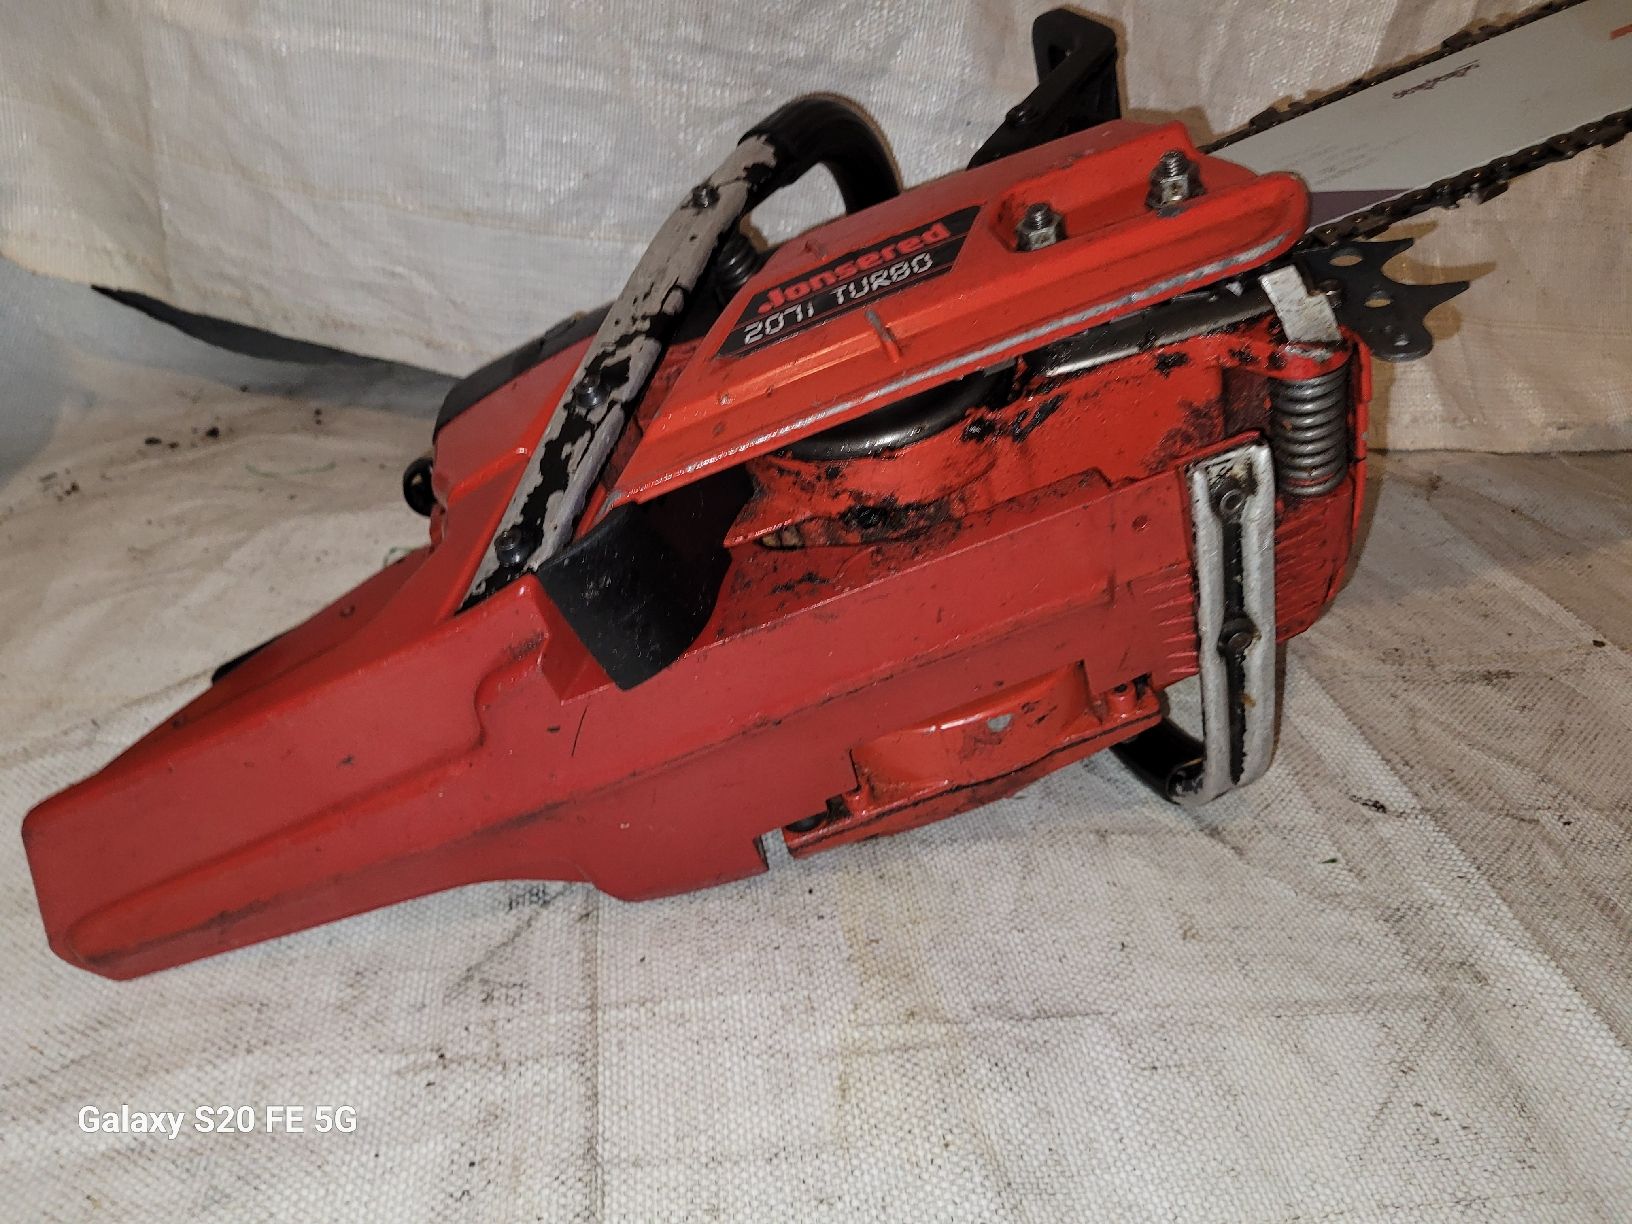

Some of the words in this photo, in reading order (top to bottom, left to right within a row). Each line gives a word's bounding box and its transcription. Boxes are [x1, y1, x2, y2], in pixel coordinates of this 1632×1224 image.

[743, 301, 815, 345] 2071
[829, 252, 934, 305] TURBO
[757, 222, 951, 315] Jonsered
